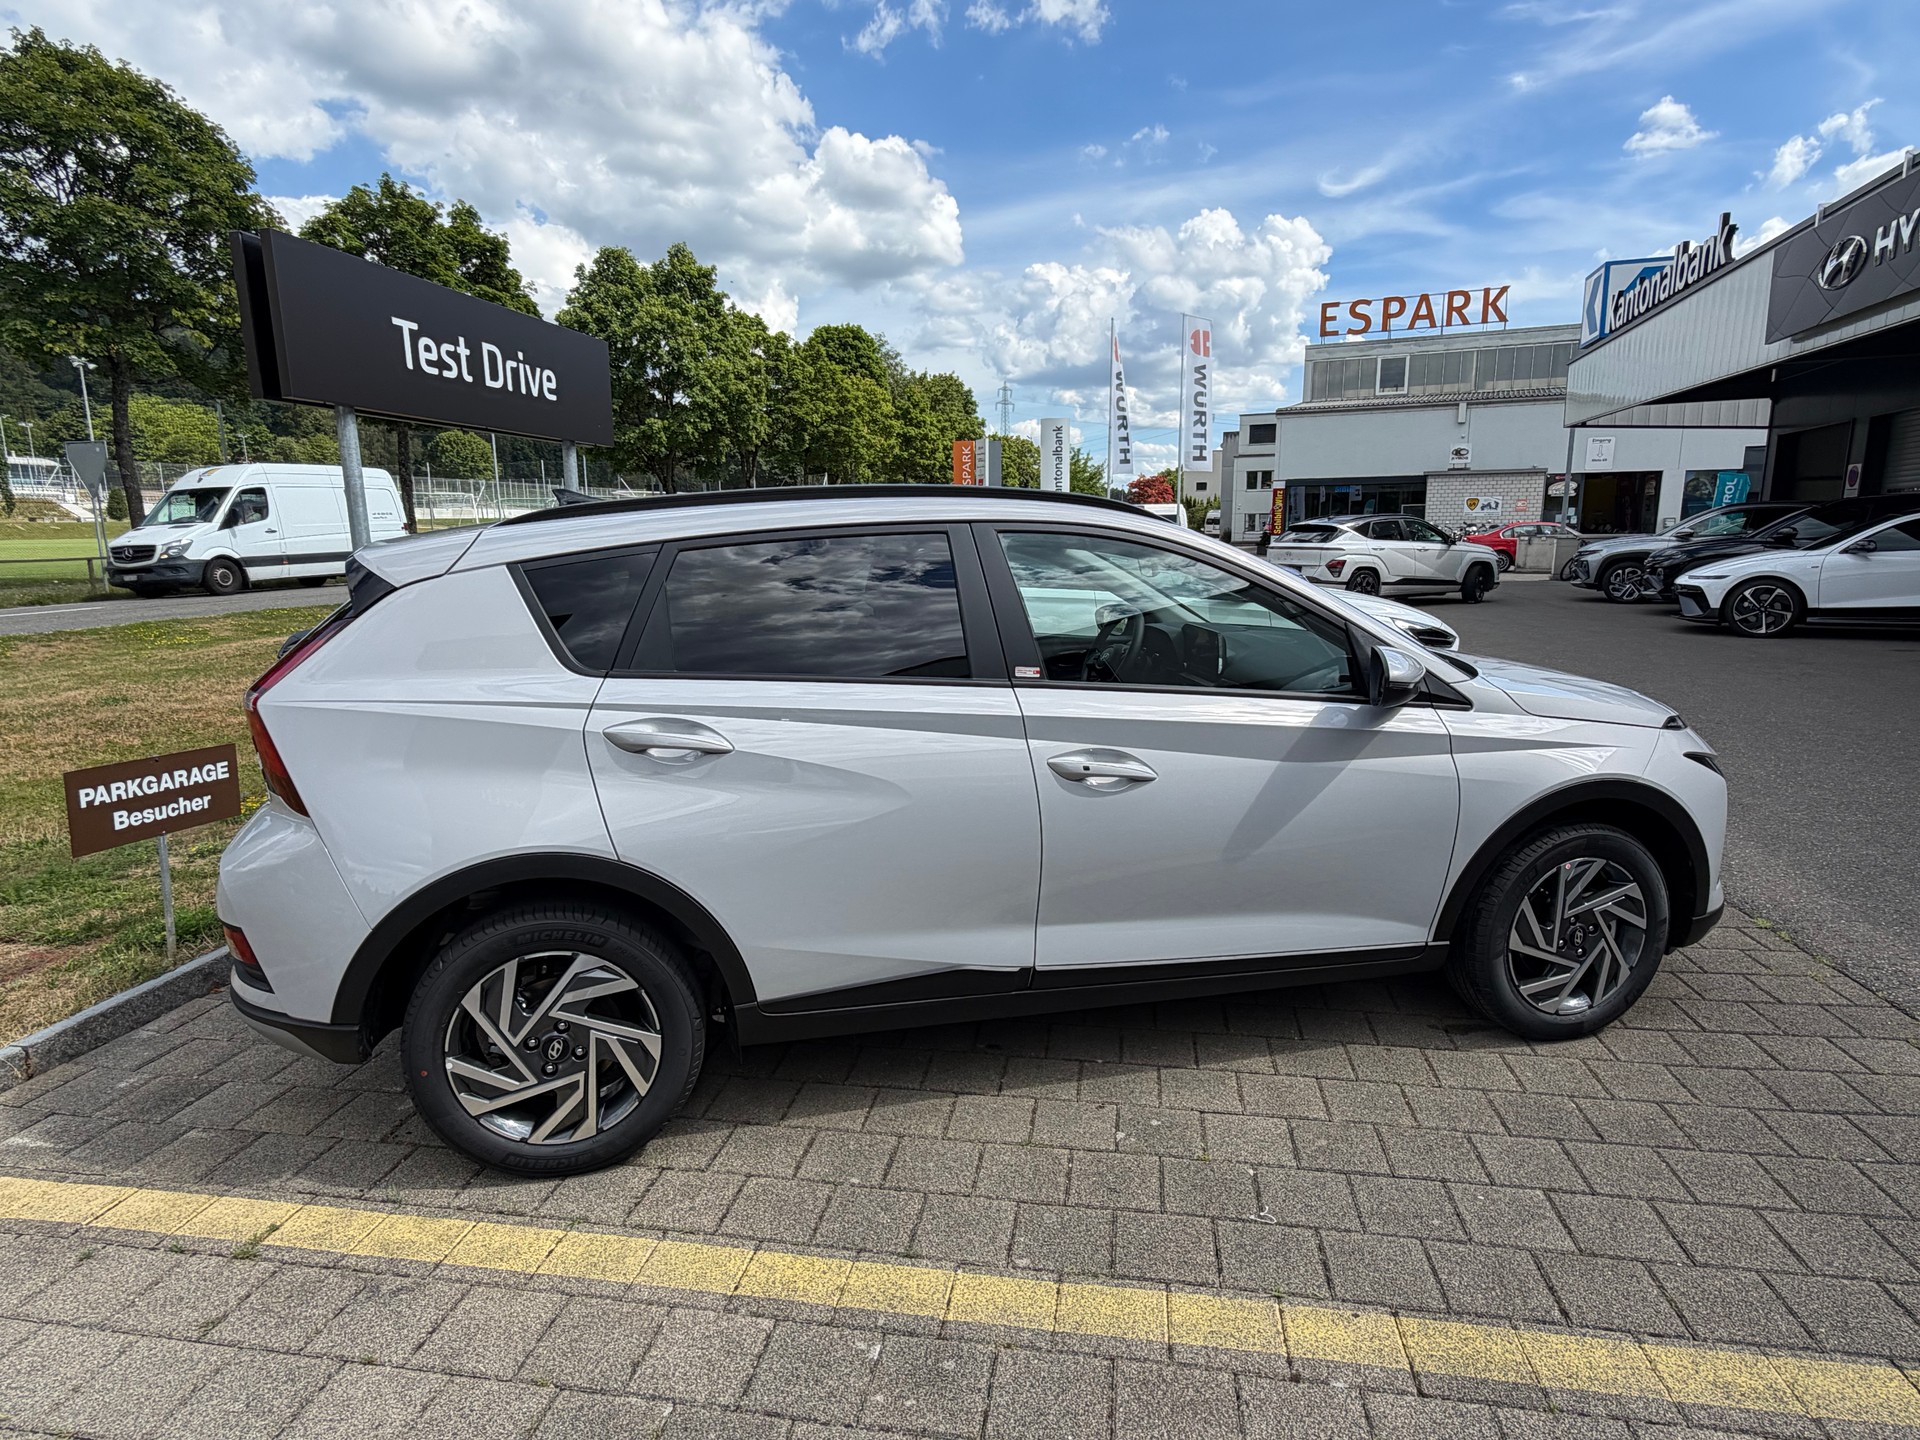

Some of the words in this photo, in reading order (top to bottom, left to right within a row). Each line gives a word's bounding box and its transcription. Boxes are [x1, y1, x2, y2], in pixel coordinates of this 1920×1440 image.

[1604, 212, 1736, 334] Kantonalbank
[1320, 285, 1511, 337] ESPARK
[391, 316, 473, 383] Test
[481, 341, 557, 401] Drive
[1192, 364, 1207, 462] WÜRTH
[78, 761, 230, 809] PARKGARAGE
[113, 795, 212, 831] Besucher
[516, 930, 605, 947] MICHELIN
